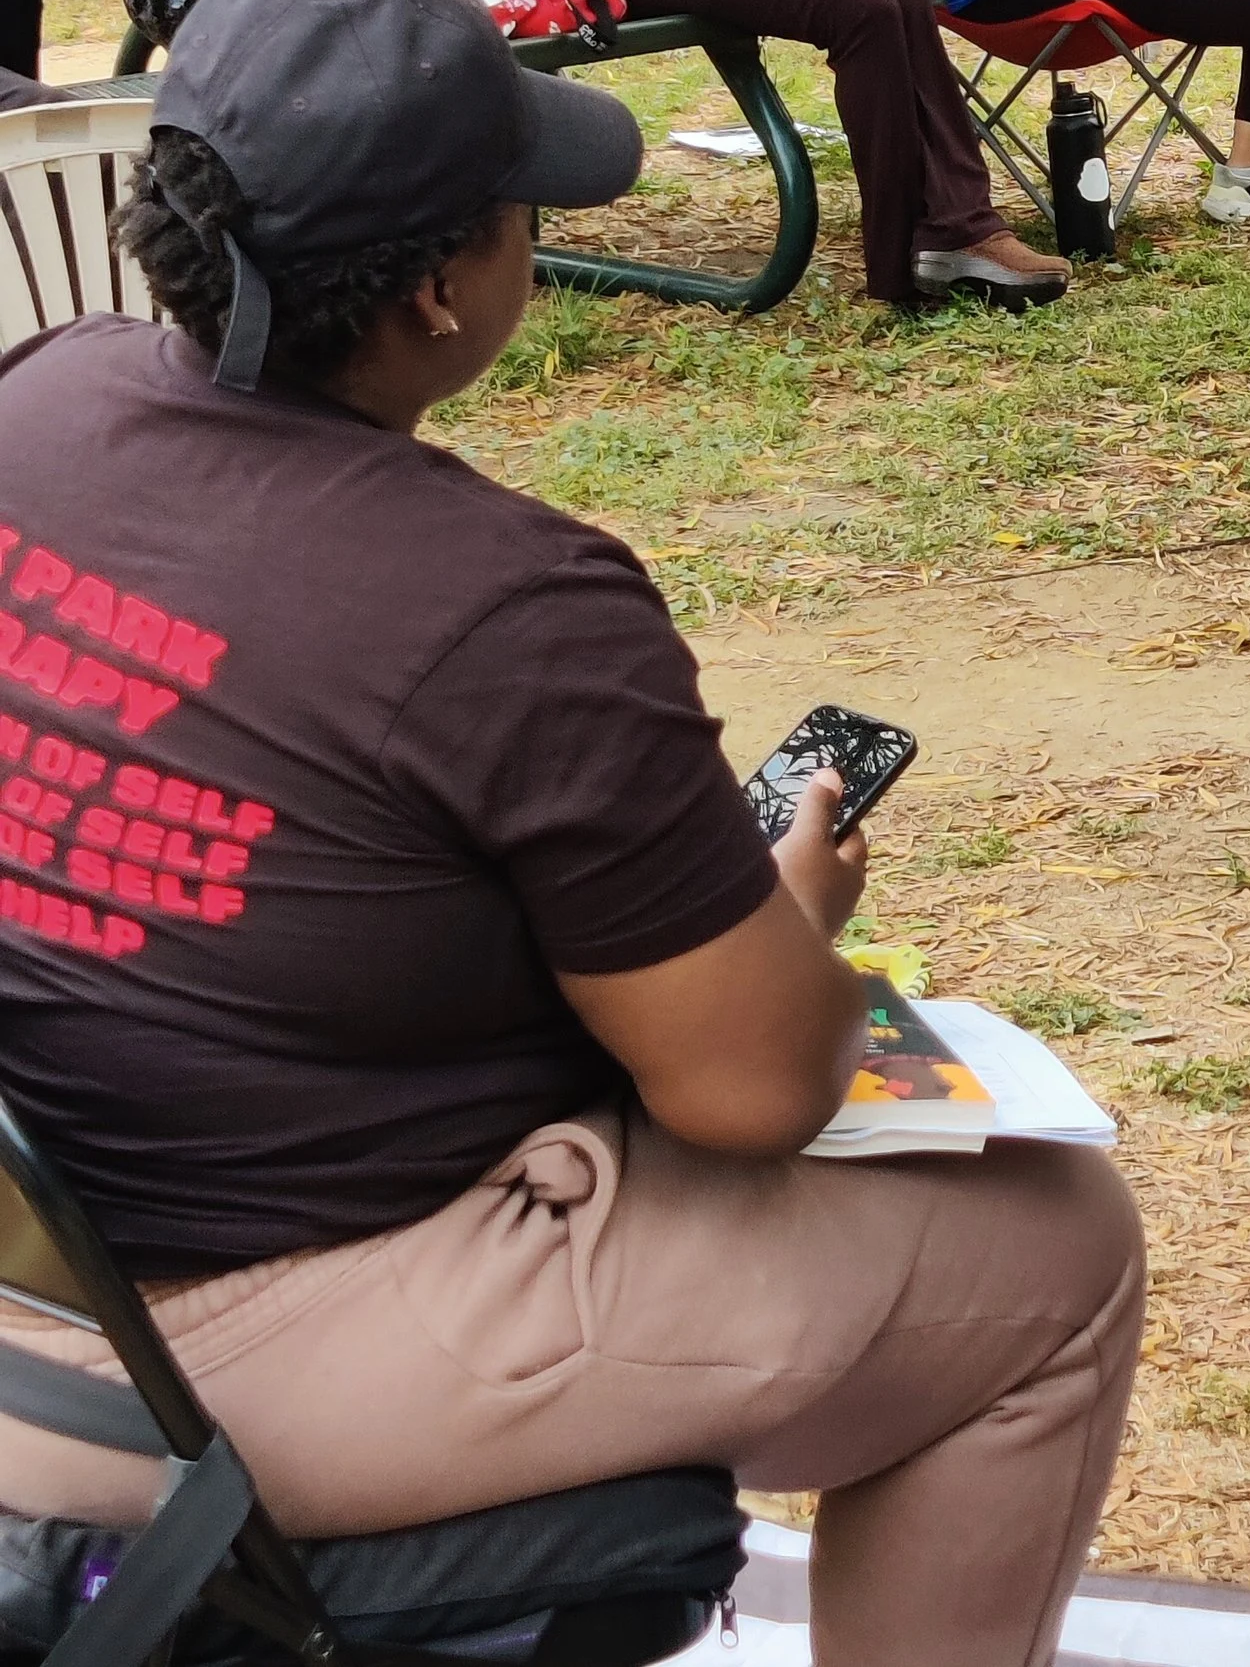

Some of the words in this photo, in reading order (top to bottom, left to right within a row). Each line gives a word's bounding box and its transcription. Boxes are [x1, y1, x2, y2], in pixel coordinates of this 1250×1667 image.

[12, 544, 229, 688] PARK
[2, 775, 74, 826] OF
[76, 804, 250, 880] SELF
[31, 735, 107, 790] OF
[111, 762, 275, 842] SELF
[66, 846, 246, 926] SELF
